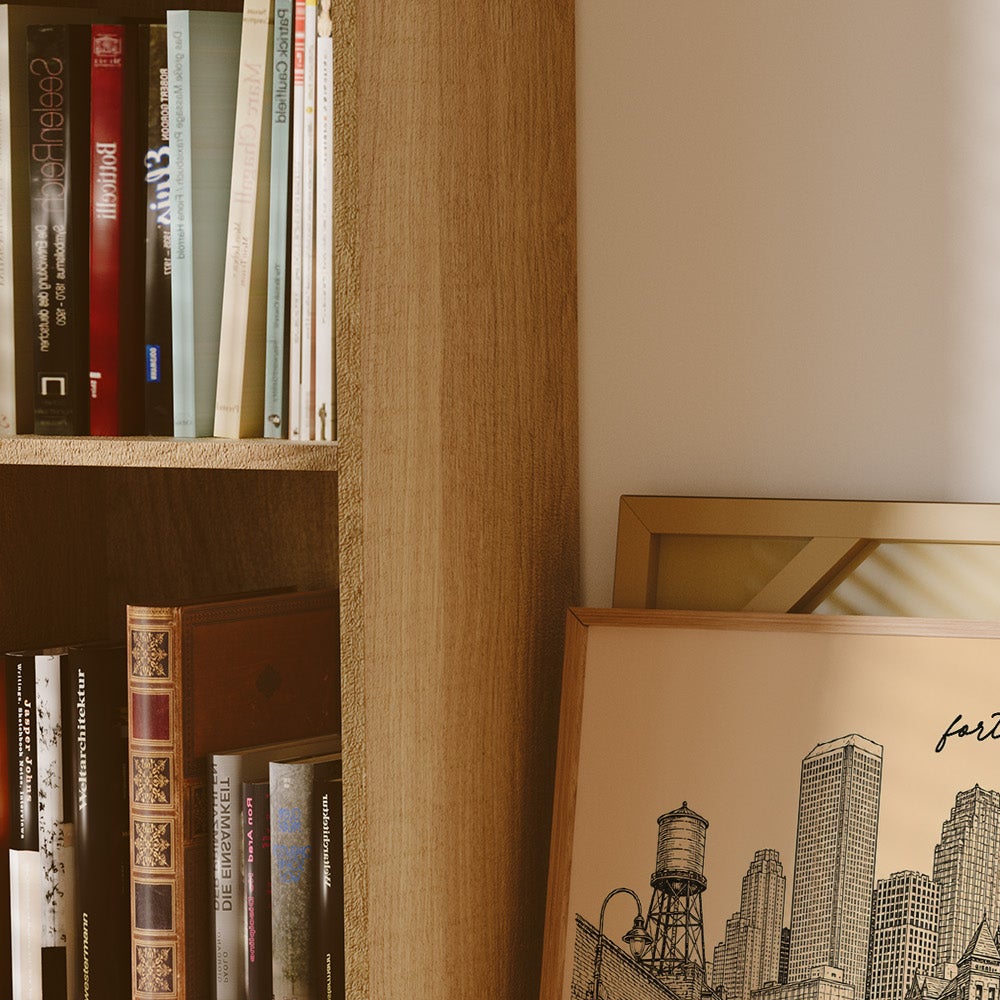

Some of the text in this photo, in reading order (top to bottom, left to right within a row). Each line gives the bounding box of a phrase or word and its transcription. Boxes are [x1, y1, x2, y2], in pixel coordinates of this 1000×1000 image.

[24, 700, 33, 803] Jasper Johns
[77, 668, 88, 812] Weltarchitektur
